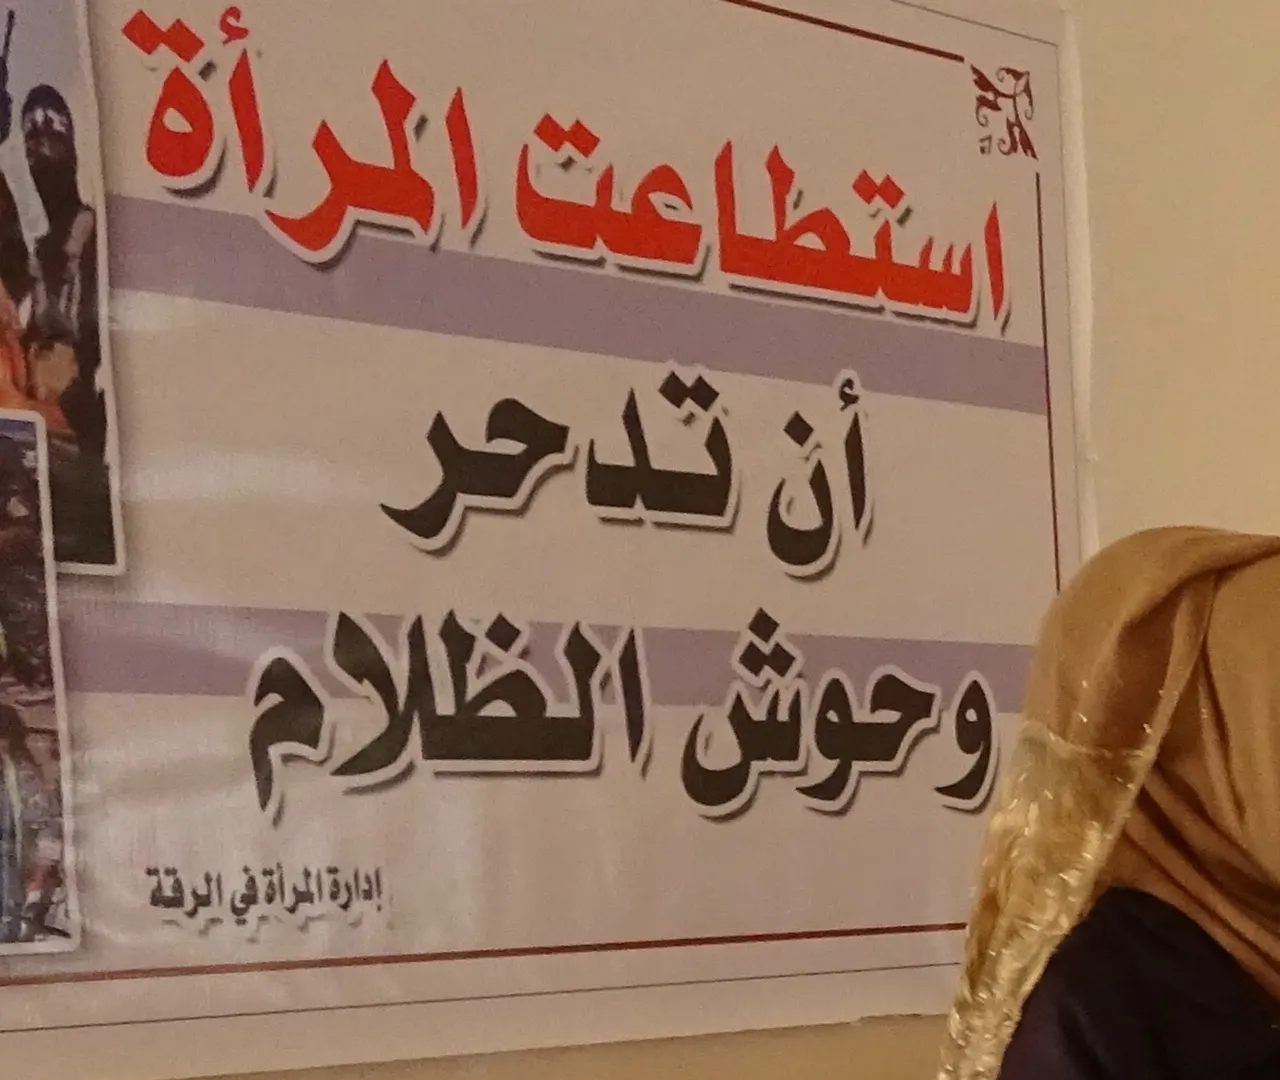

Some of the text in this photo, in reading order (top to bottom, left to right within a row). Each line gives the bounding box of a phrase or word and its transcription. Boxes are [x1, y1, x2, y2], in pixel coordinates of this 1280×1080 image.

[122, 7, 1005, 322] استطاعت المرأة
[381, 371, 867, 564] أن تدحر
[249, 609, 993, 809] وحوش الظلام
[145, 861, 382, 926] إدارة المرأة في الرقة
